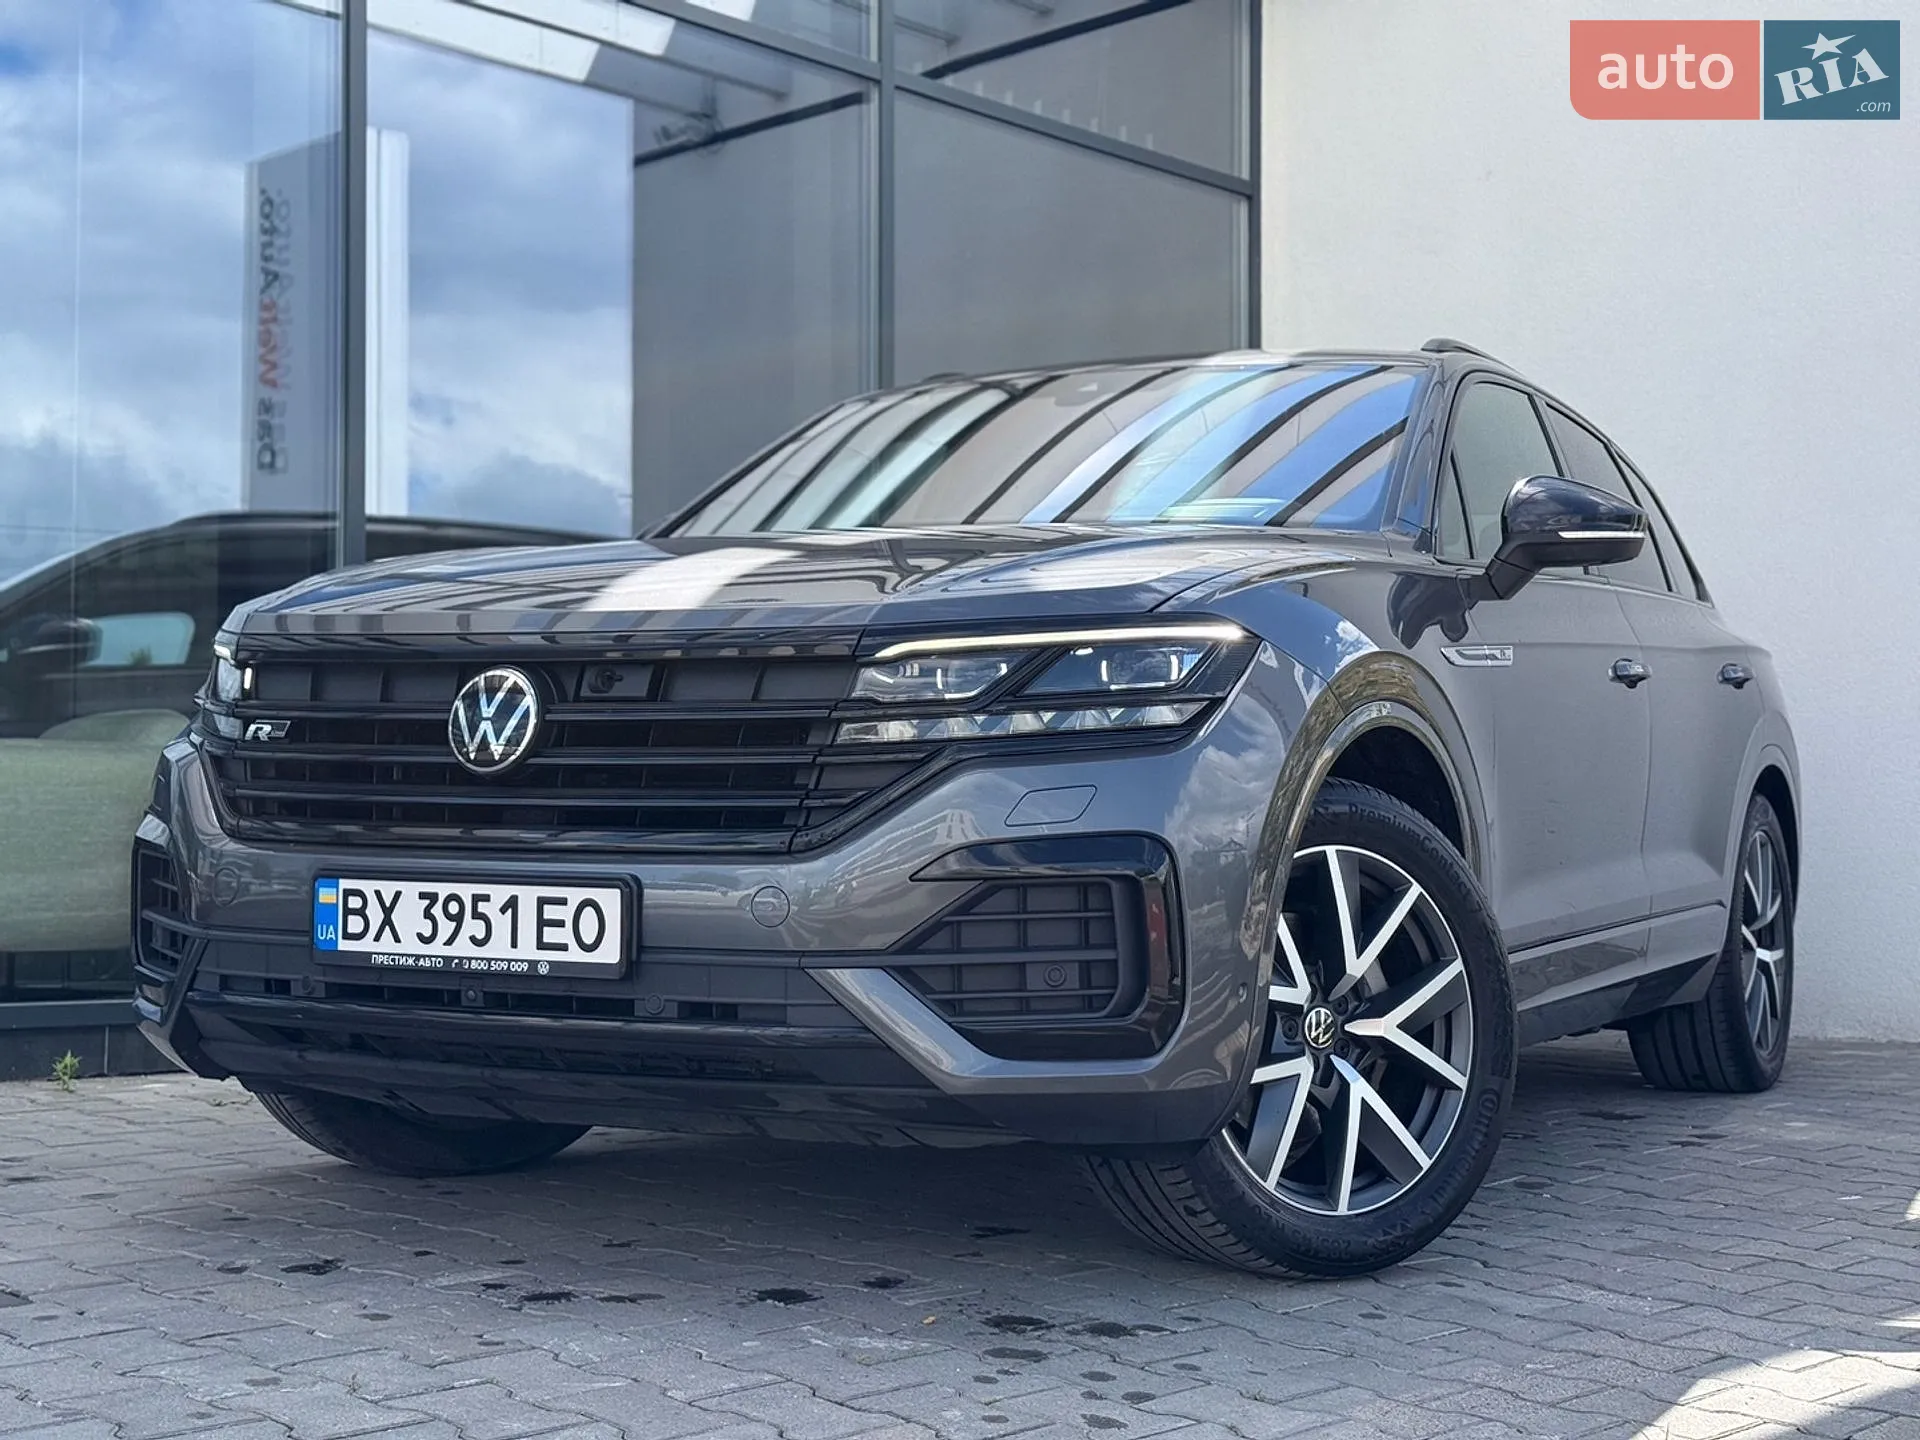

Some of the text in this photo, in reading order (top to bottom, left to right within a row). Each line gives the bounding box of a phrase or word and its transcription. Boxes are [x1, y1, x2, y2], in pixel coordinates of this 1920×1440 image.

[341, 888, 606, 953] BX 3951 EO
[318, 924, 336, 940] UA
[371, 954, 443, 968] ПРЕСТИЖ-АВТО
[470, 959, 488, 970] 800
[490, 960, 508, 971] 509
[510, 961, 529, 972] 009
